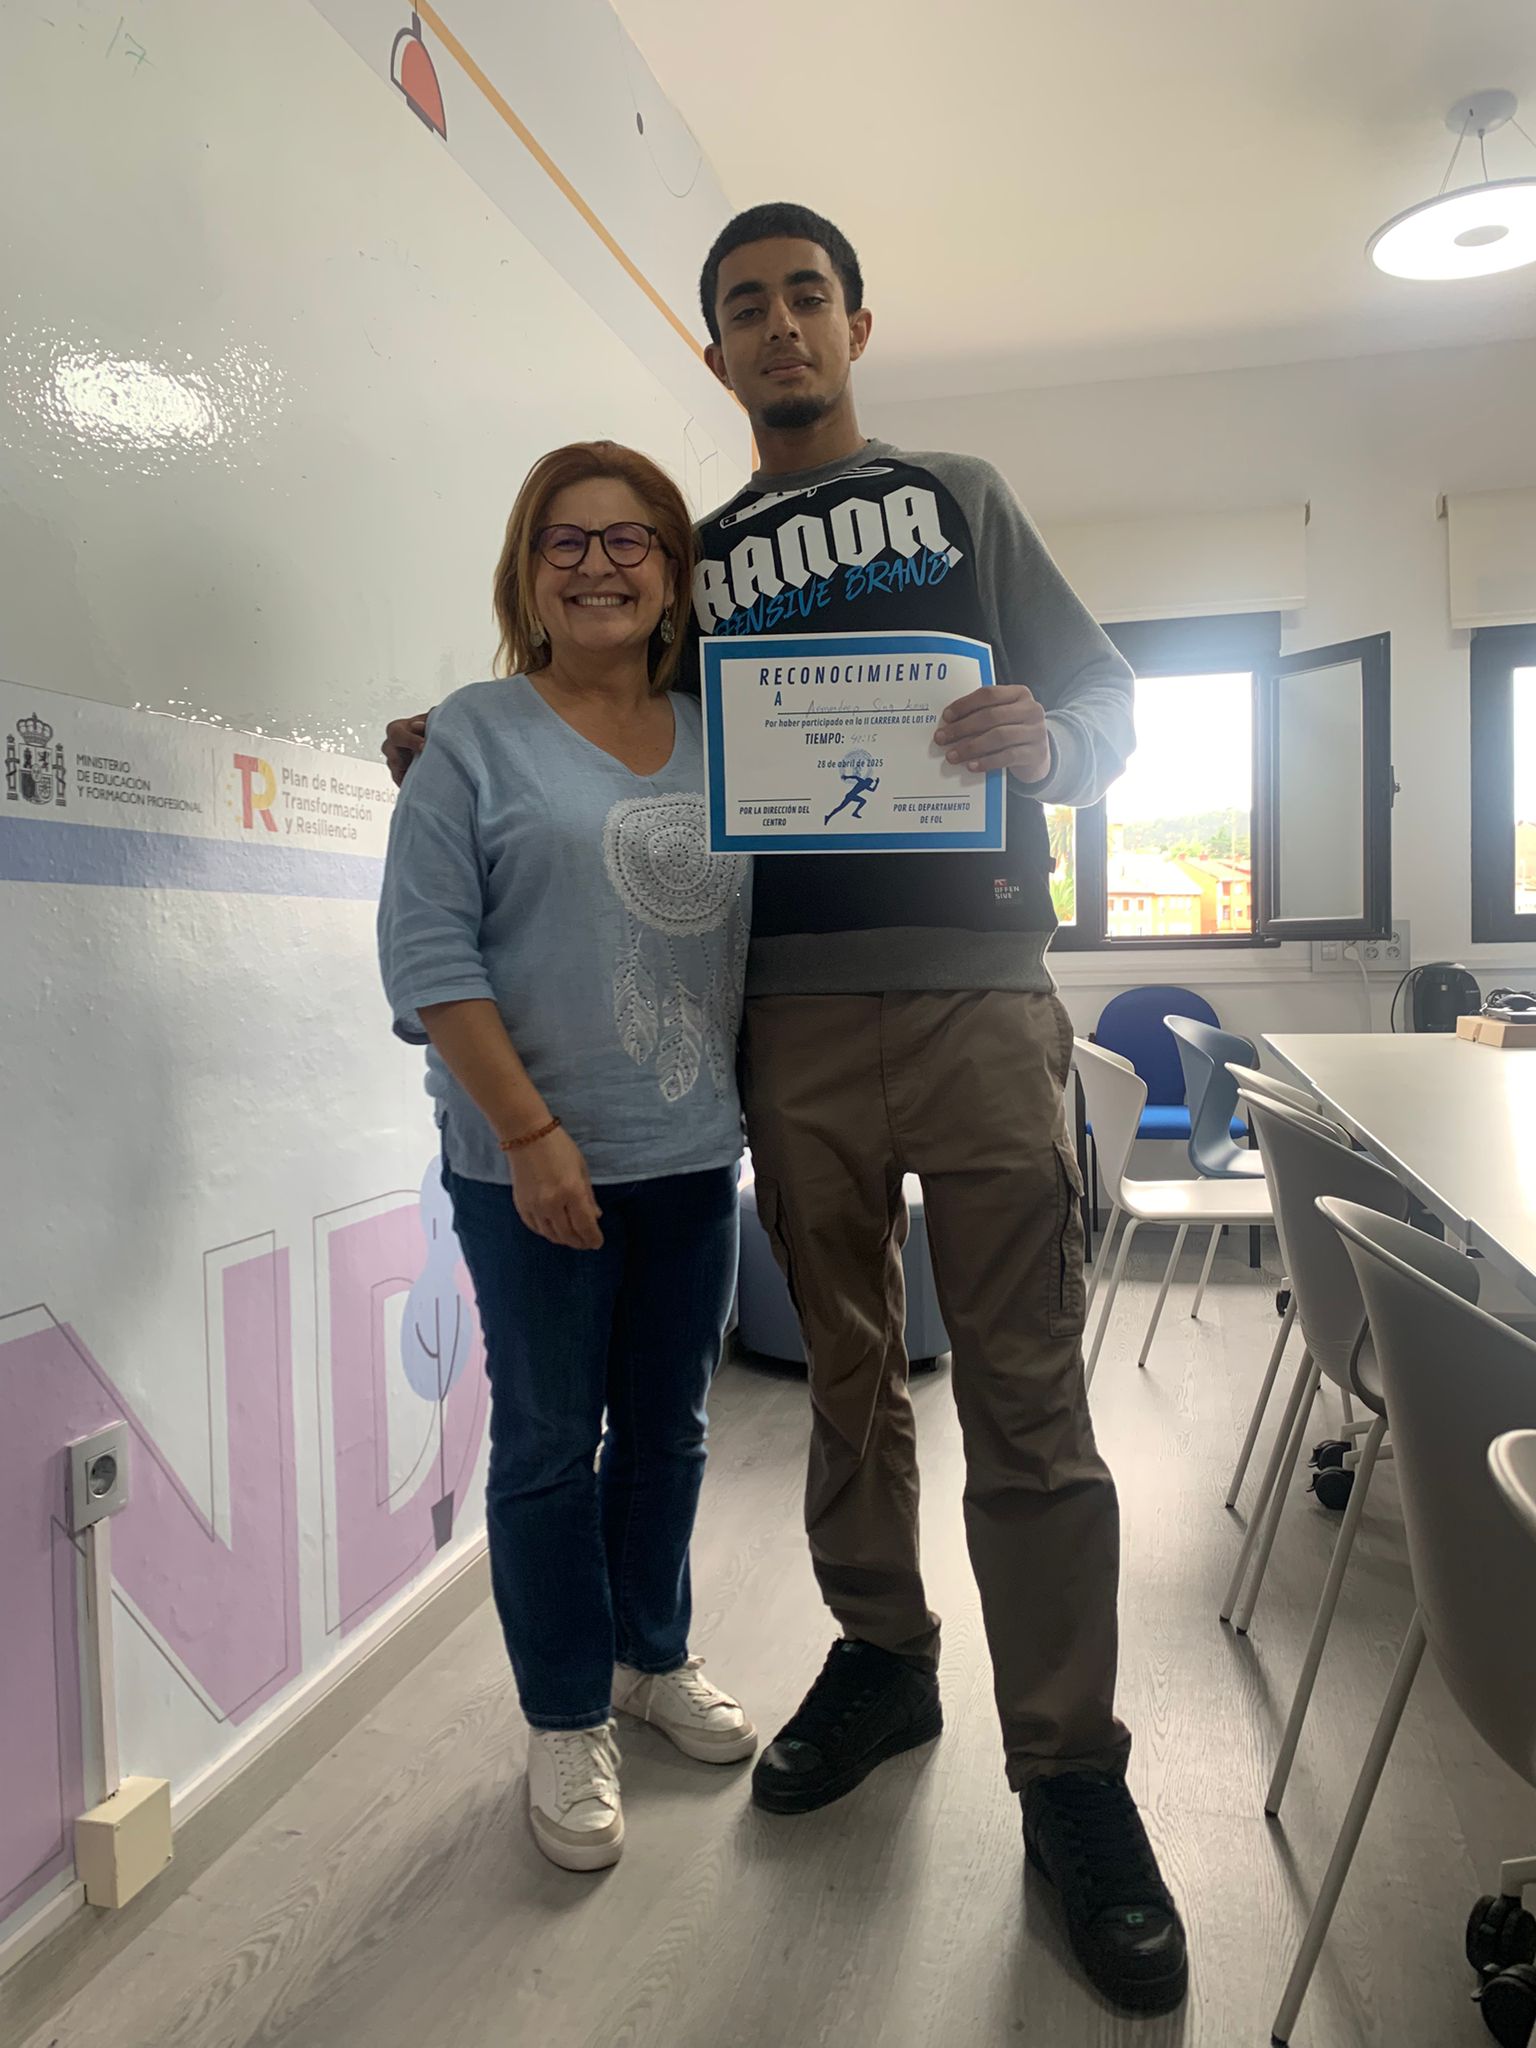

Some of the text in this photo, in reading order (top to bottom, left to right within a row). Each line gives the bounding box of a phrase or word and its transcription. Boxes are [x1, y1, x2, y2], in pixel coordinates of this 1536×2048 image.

[844, 542, 950, 601] BRAND
[759, 663, 948, 686] RECONOCIMIENTO
[774, 691, 782, 706] A
[764, 719, 778, 728] Por
[779, 719, 800, 728] haber
[801, 718, 843, 729] participado
[856, 716, 862, 725] la
[864, 716, 870, 725] II
[870, 716, 900, 725] CARRERA
[902, 716, 910, 724] DE
[912, 715, 924, 724] LOS
[805, 732, 845, 745] TIEMPO:
[76, 753, 131, 773] MINISTERIO
[817, 758, 884, 768] 28 de abril de 2025
[77, 769, 90, 783] DE
[77, 785, 85, 798] Y
[281, 767, 396, 804] Plan de Recuperació
[281, 791, 373, 822] Transformación
[739, 804, 810, 814] POR LA DIRECCIÓN DEL
[893, 802, 970, 812] POR EL DEPARTAMENTO
[762, 818, 786, 826] CENTRO
[920, 816, 943, 824] DE FOL
[284, 815, 358, 840] y Resiliencia
